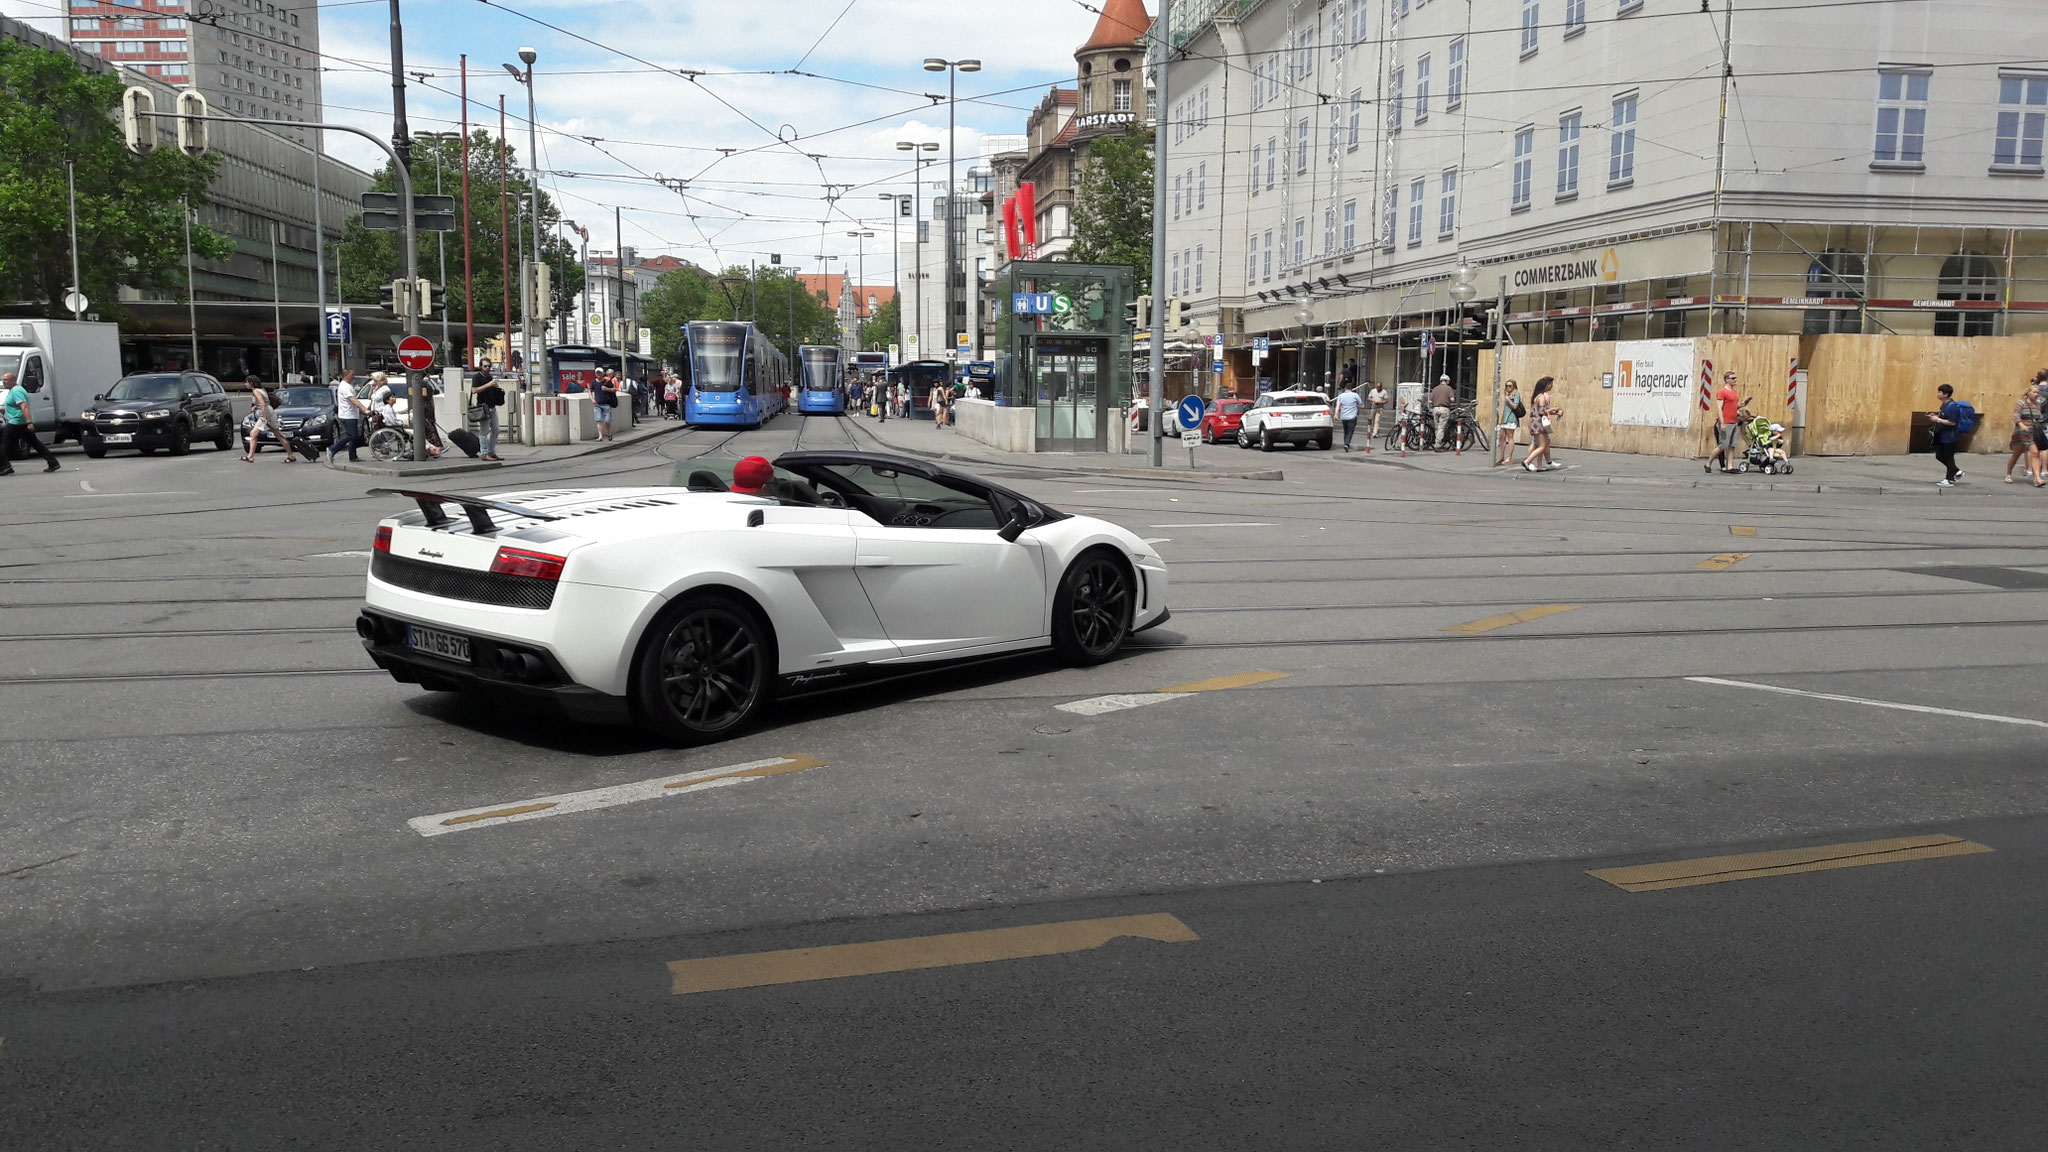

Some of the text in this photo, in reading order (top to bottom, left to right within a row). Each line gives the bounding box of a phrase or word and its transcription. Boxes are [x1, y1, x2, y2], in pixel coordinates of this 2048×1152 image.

[902, 201, 911, 215] E
[1515, 260, 1597, 287] COMMERZBANK
[1036, 296, 1069, 312] U S
[1781, 297, 1825, 305] GEMEINHARDT
[1912, 299, 1956, 307] GEMEINHARDT
[1635, 370, 1688, 393] hagenauer
[412, 628, 430, 649] STA
[450, 637, 470, 659] 570
